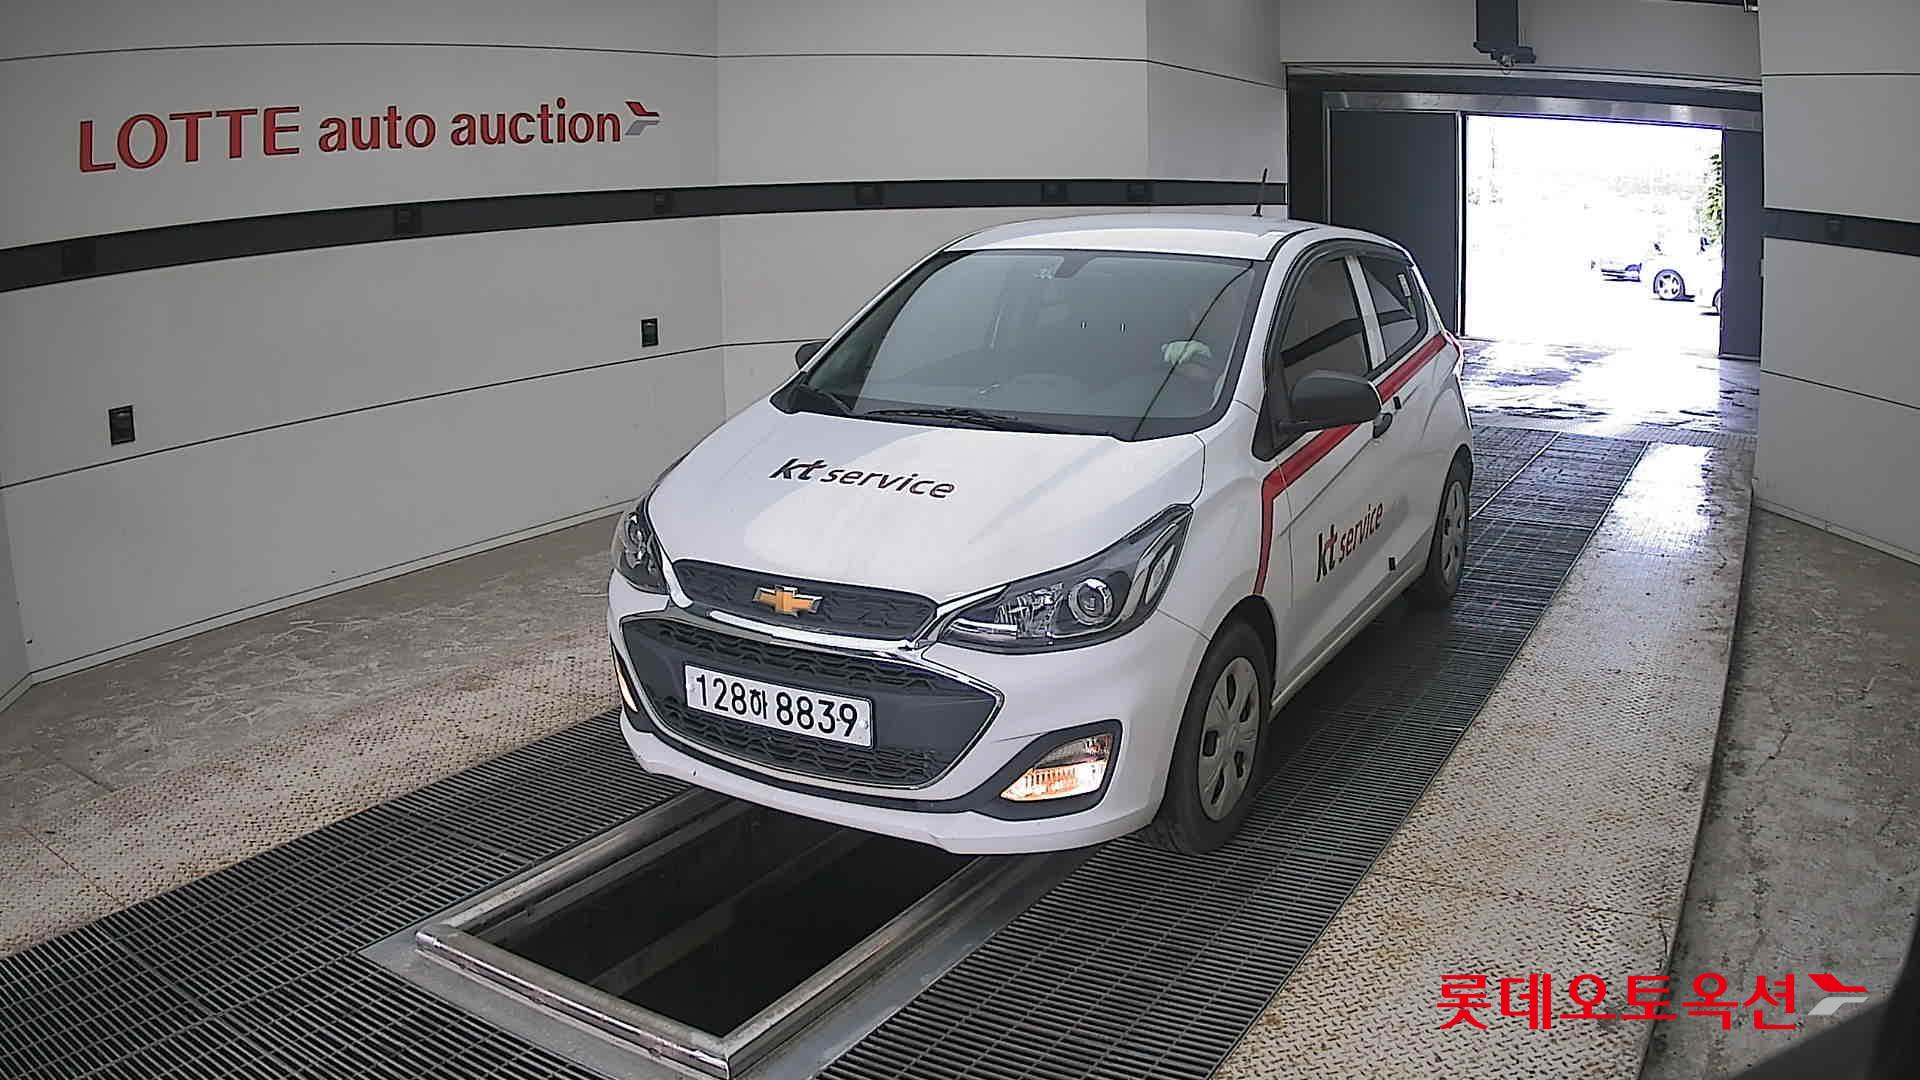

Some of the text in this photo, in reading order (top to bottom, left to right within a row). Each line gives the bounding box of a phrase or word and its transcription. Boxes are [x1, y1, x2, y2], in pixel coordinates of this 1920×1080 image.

[80, 97, 621, 172] LOTTE auto auction
[769, 458, 955, 498] kt service
[1316, 503, 1383, 582] kt service
[696, 674, 858, 738] 128하 8839
